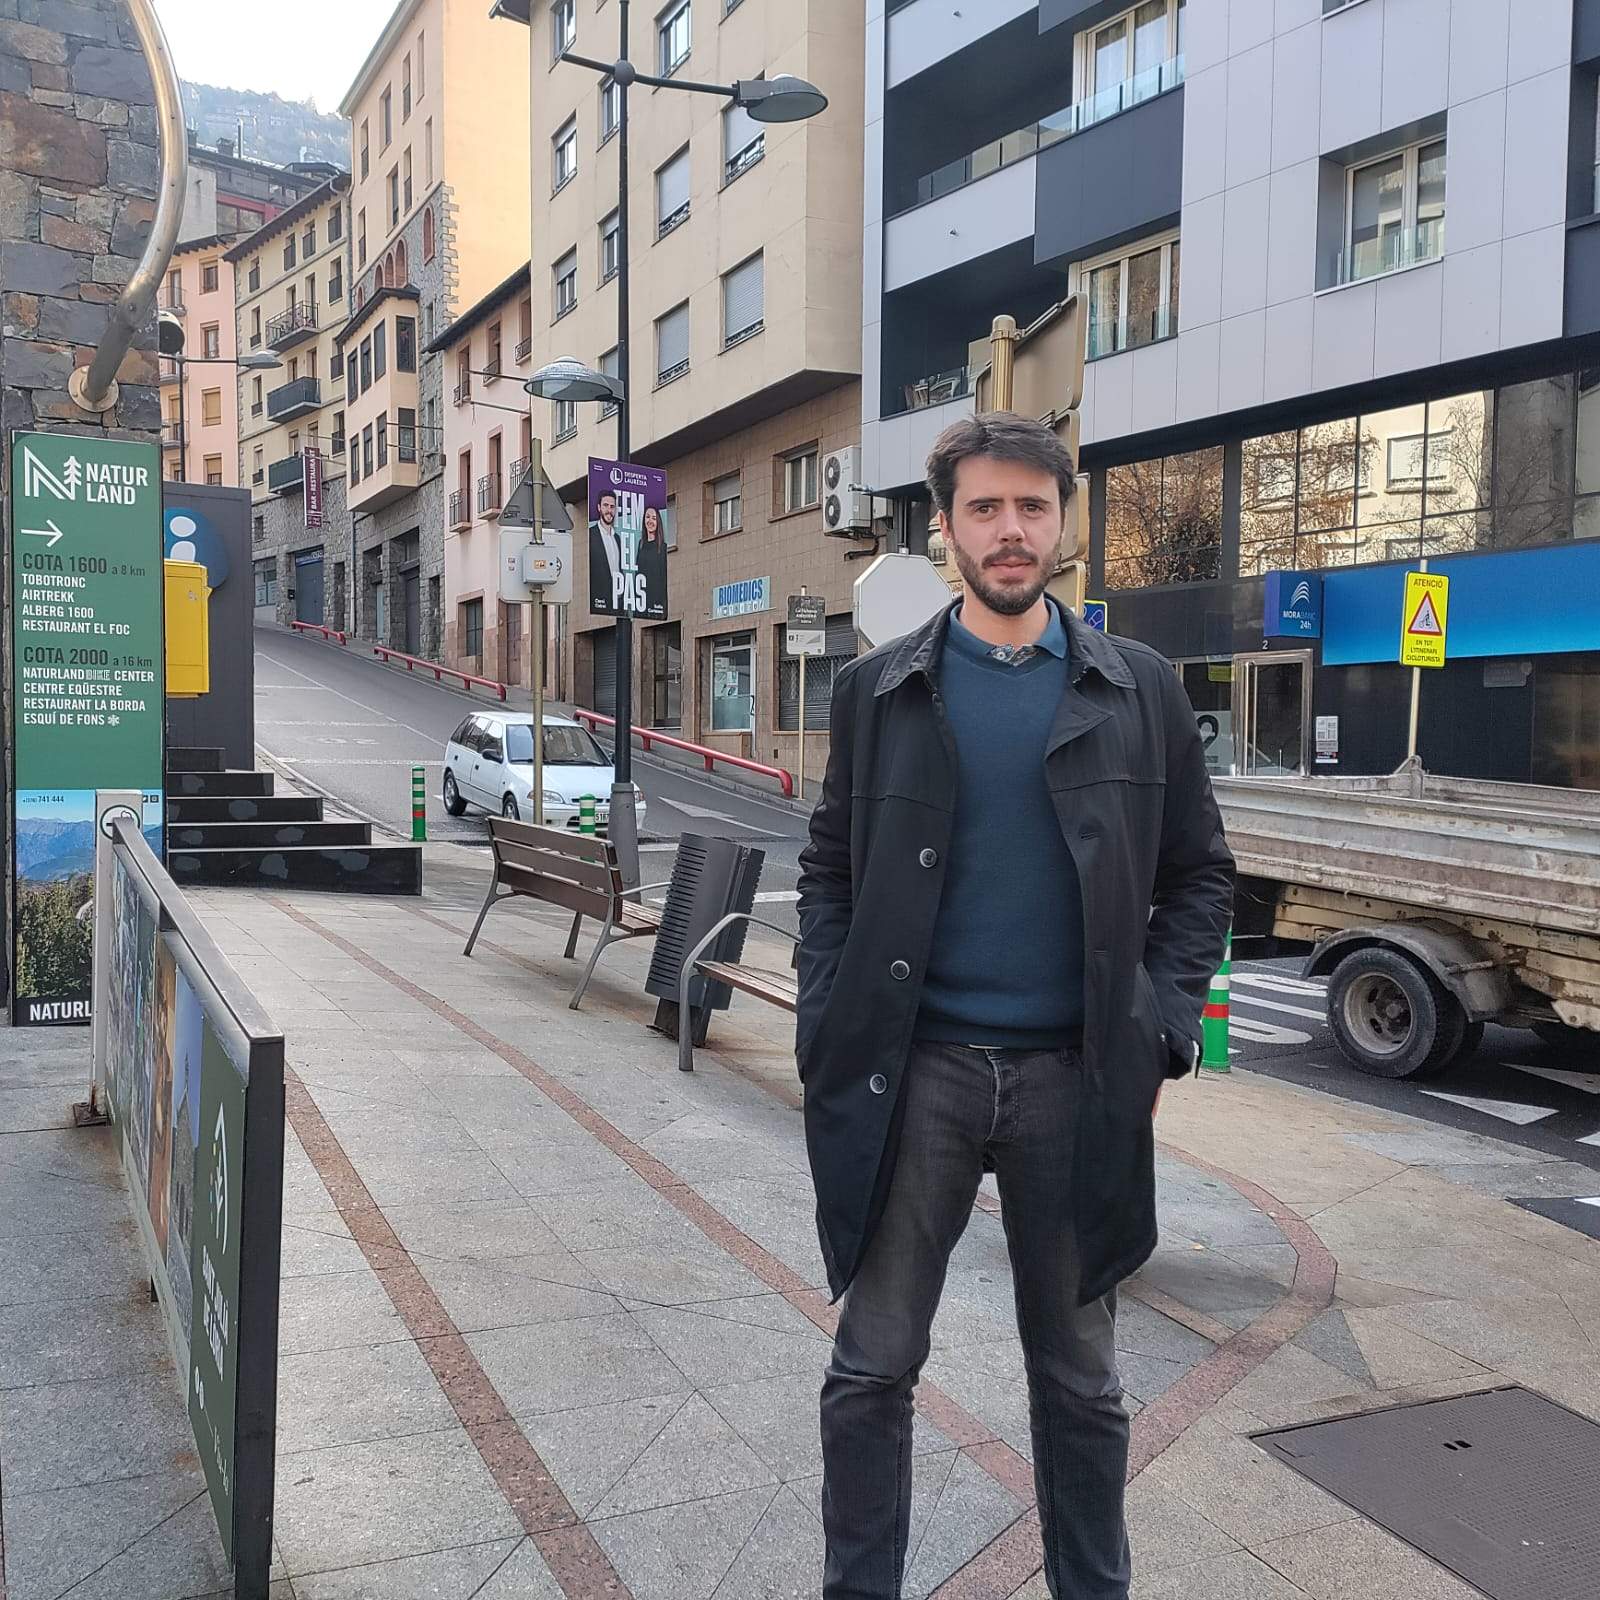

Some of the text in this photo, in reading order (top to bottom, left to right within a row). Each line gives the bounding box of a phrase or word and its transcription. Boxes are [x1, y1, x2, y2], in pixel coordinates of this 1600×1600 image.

[85, 462, 148, 487] NATUR
[86, 482, 136, 505] LAND
[614, 490, 645, 531] FEM
[621, 531, 639, 571] EL
[22, 553, 146, 577] COTA 1600 a 8 km
[22, 574, 86, 588] TOBOTRONC
[22, 589, 75, 602] AIRTREKK
[612, 571, 647, 613] PAS
[718, 579, 763, 607] BIOMEDICS
[22, 605, 94, 619] ALBERG 1600
[22, 620, 130, 635] RESTAURANT EL FOC
[1300, 620, 1312, 630] 24h
[1262, 640, 1268, 650] 2
[24, 646, 153, 667] COTA 2000 a 16 km
[114, 670, 154, 682] CENTER
[24, 683, 122, 696] CENTRE EQÜESTRE
[24, 698, 146, 712] RESTAURANT LA BORDA
[24, 711, 105, 726] ESQUÍ DE FONS
[30, 1001, 92, 1021] NATURL
